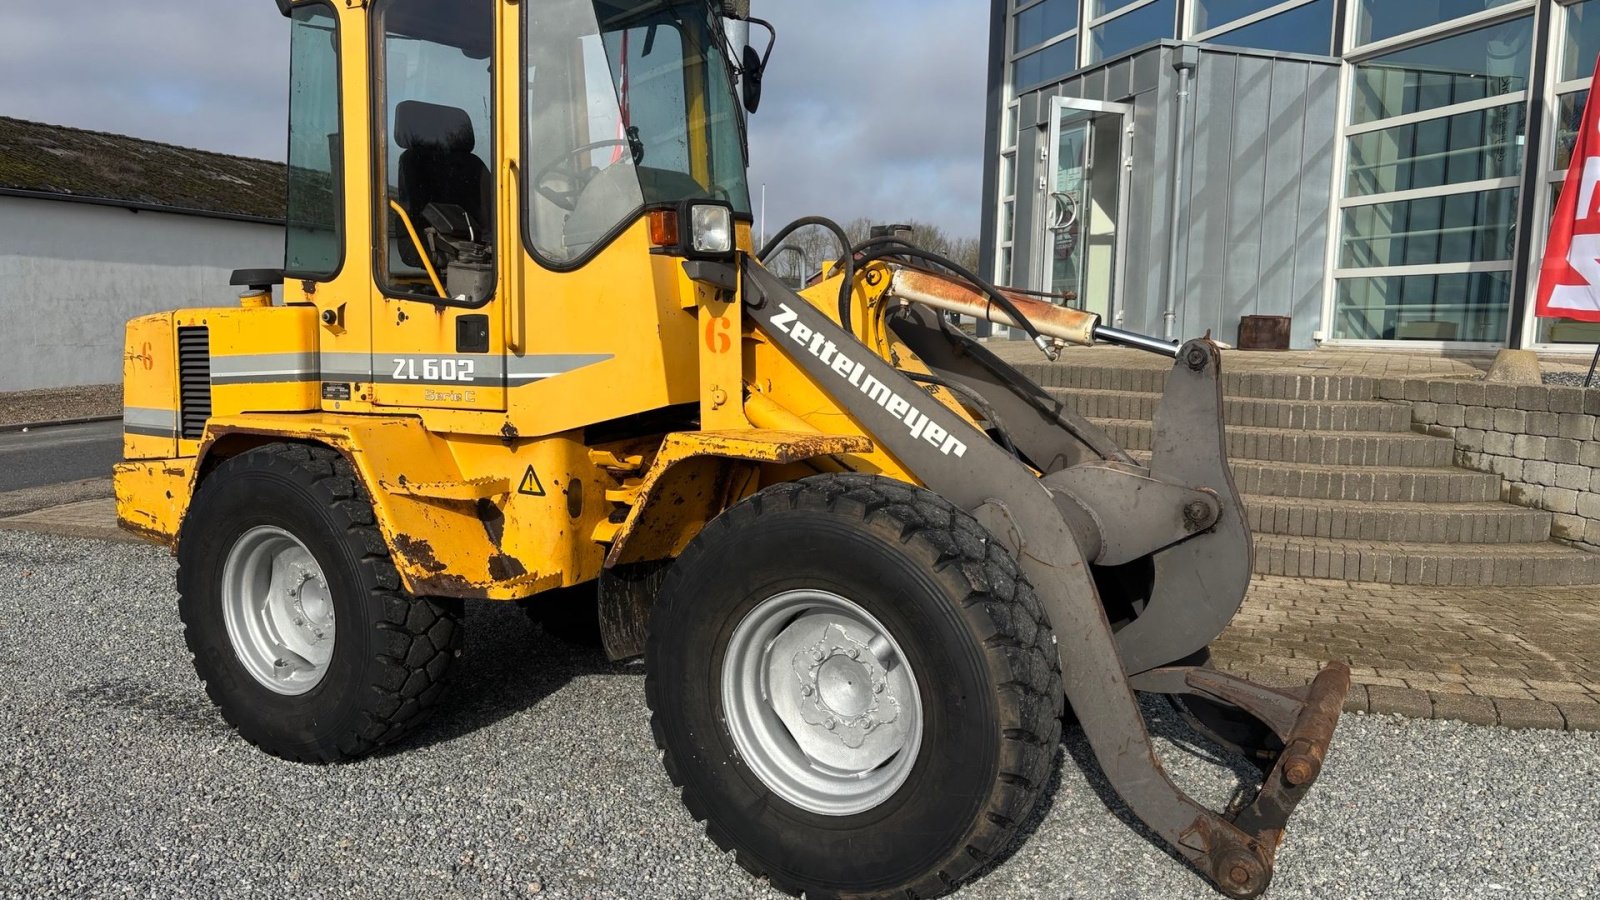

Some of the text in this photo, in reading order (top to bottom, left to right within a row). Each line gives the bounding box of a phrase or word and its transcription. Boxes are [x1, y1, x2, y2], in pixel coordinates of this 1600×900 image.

[705, 316, 731, 354] 6
[392, 358, 474, 382] ZL602
[769, 302, 968, 458] Zettelmeyer
[424, 389, 476, 403] Serie C
